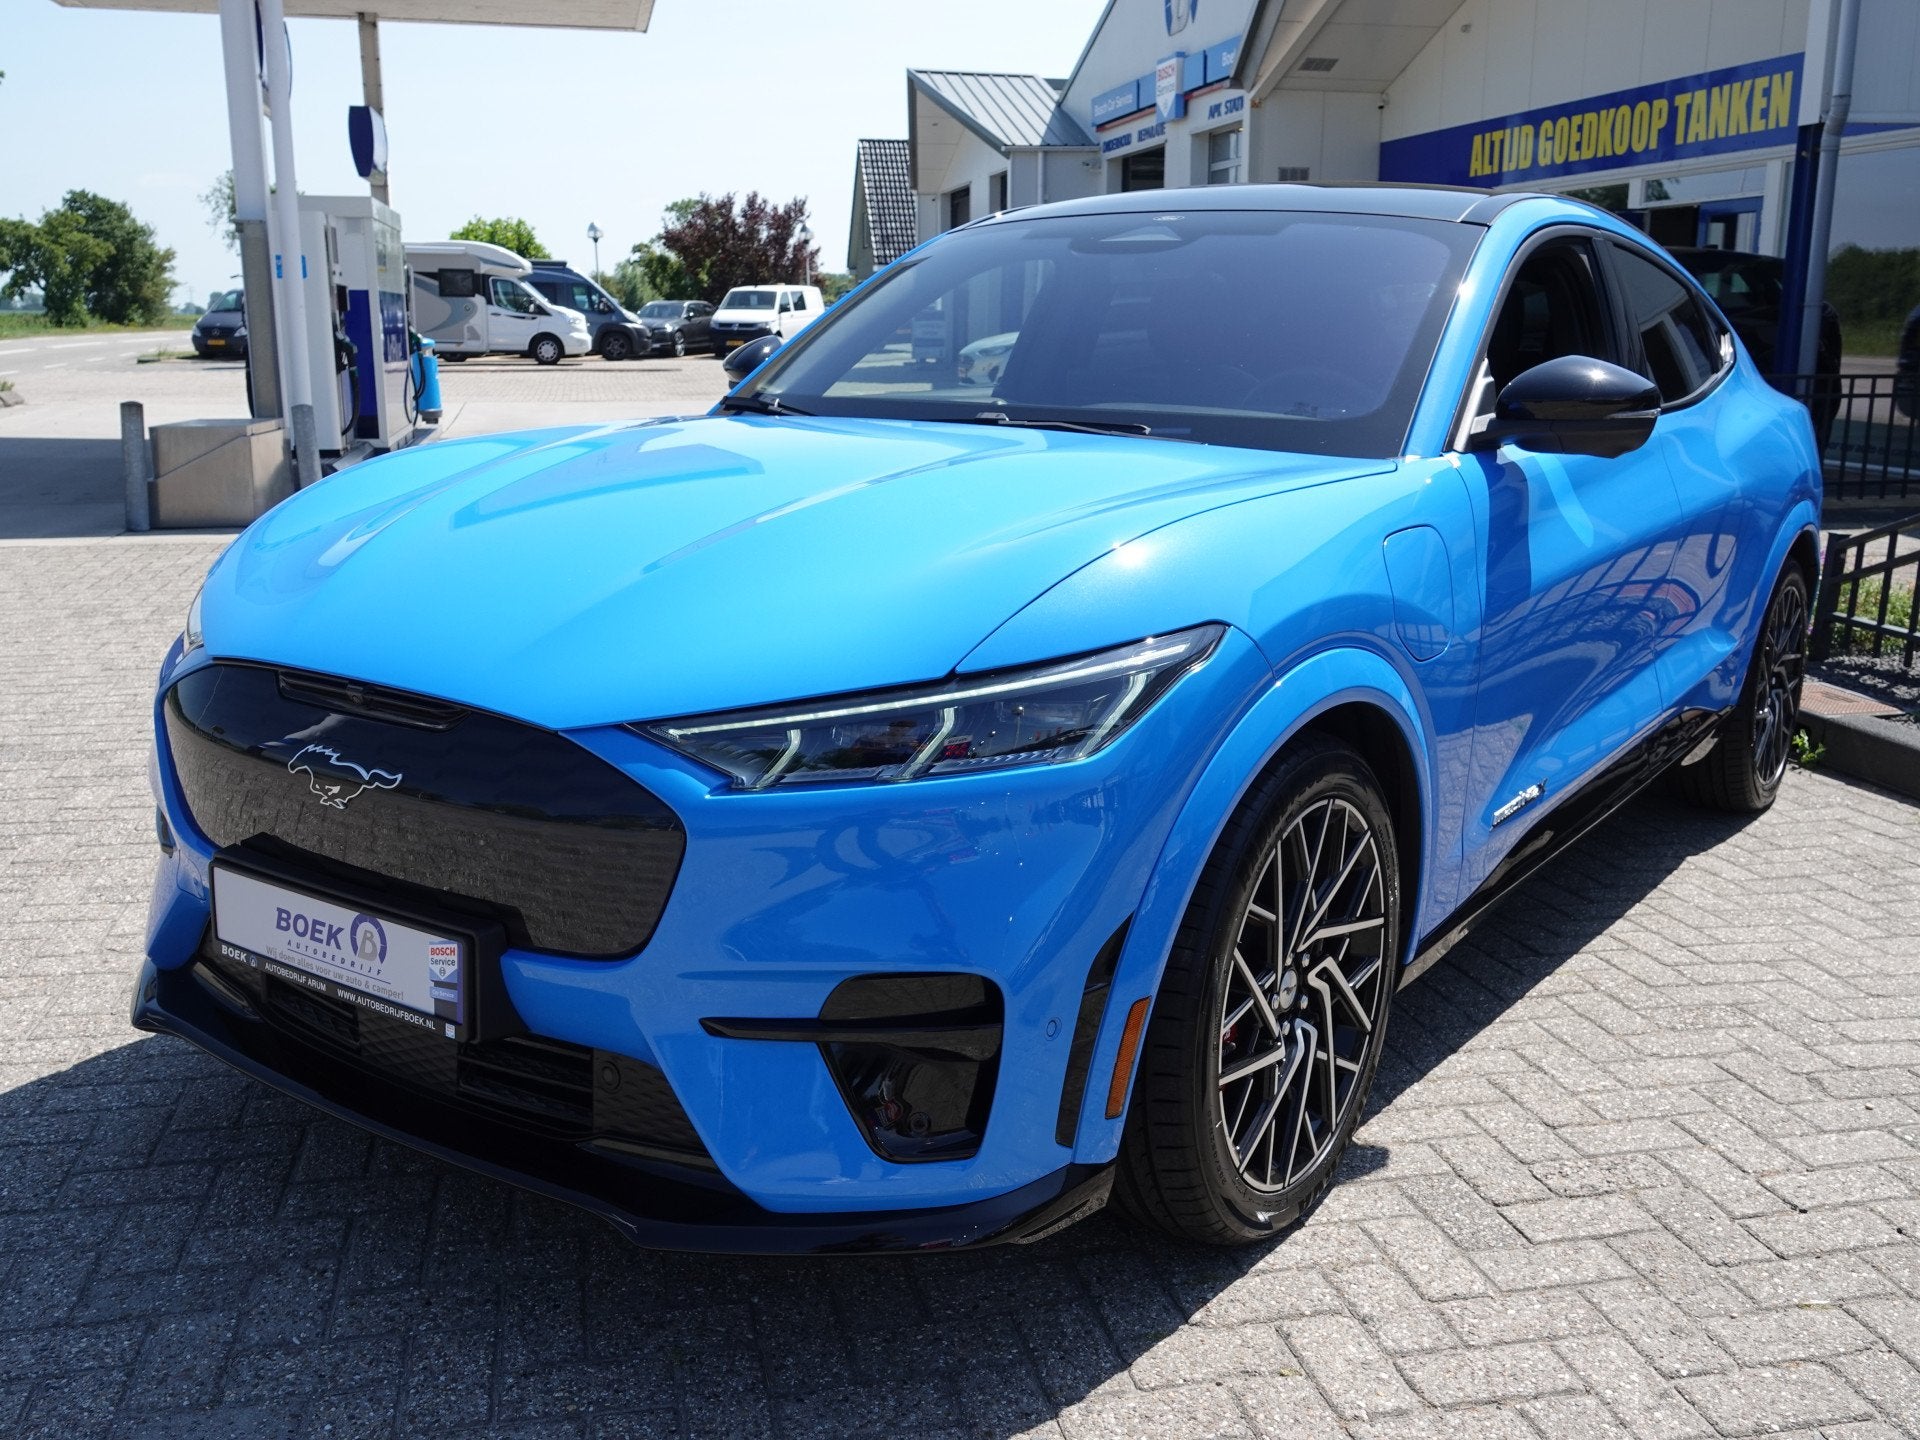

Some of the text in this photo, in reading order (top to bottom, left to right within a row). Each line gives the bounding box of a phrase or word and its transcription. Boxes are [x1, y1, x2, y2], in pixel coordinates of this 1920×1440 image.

[1208, 103, 1222, 120] APK
[1468, 70, 1794, 178] ALTIJD GOEDKOOP TANKEN
[276, 907, 344, 951] BOEK
[221, 944, 247, 963] BOEK
[287, 939, 382, 976] AUTOBEDRIJF
[430, 947, 456, 956] BOSCH
[430, 957, 456, 967] Service
[264, 962, 327, 992] AUTOBEDRIJF ARUM
[265, 944, 278, 959] Wij
[279, 950, 295, 964] doen
[297, 957, 314, 971] alles
[315, 964, 331, 976] voor
[333, 971, 344, 981] uw
[345, 974, 363, 987] auto
[372, 984, 404, 1001] camper!
[337, 988, 436, 1030] WWW.AUTOBEDRIJFBOEK.NL
